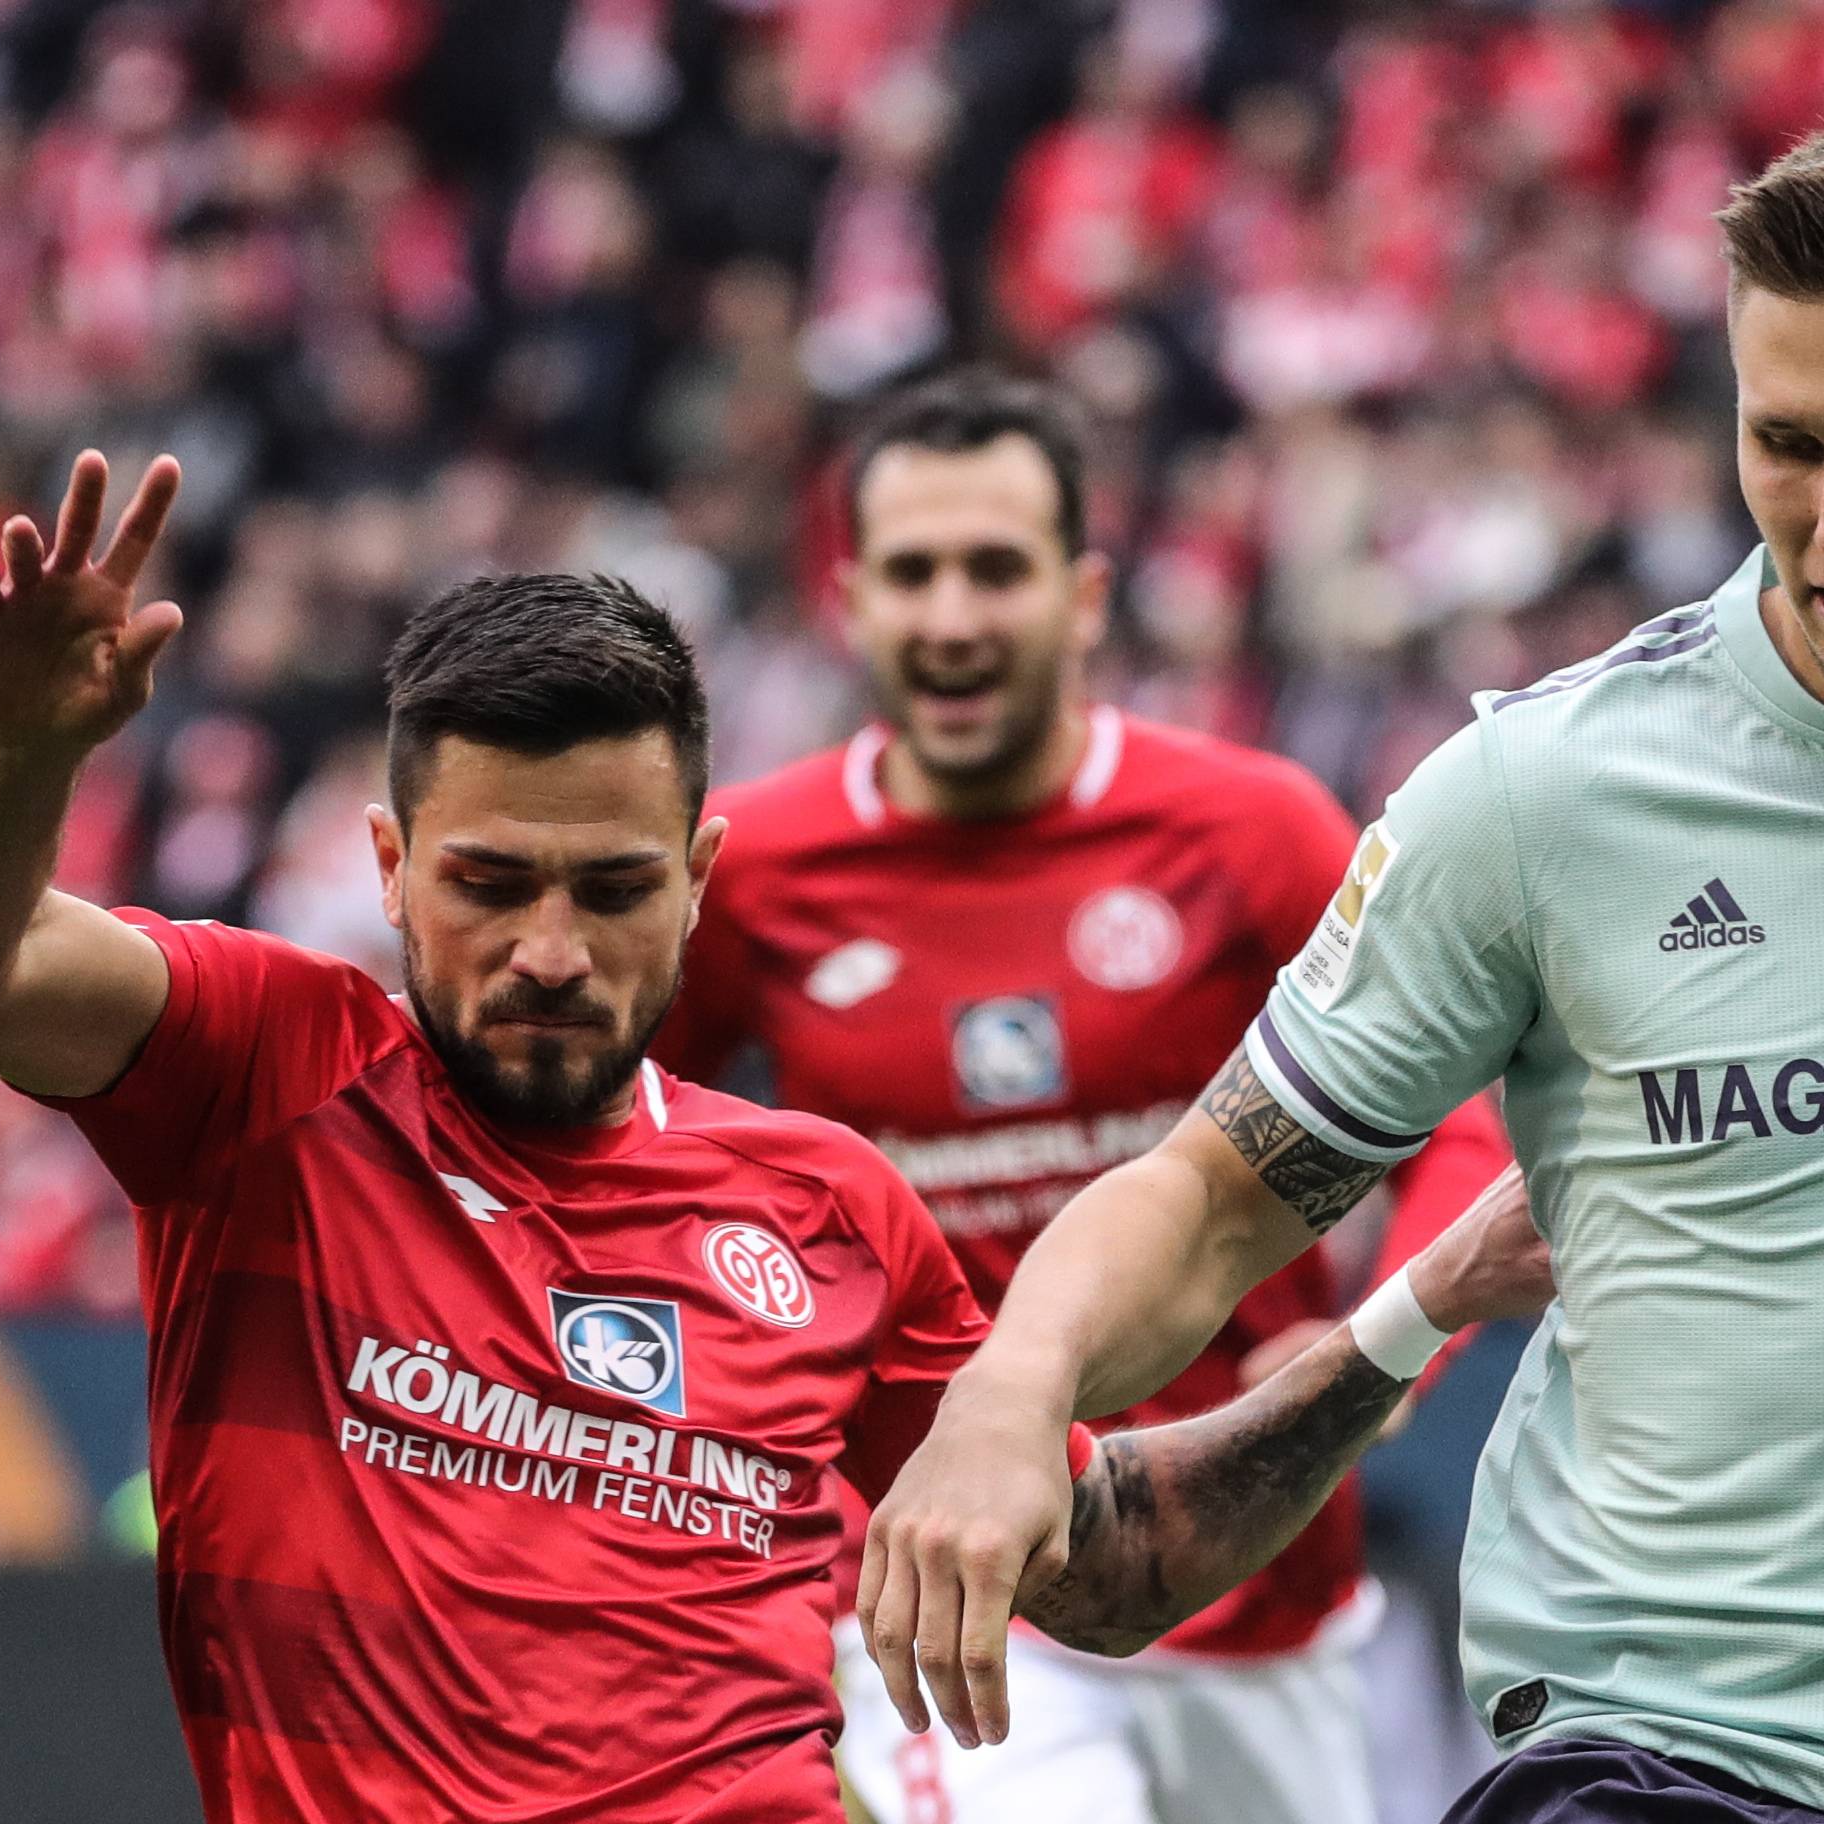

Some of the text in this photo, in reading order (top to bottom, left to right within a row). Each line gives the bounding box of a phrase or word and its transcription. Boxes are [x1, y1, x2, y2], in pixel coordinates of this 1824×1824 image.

[1659, 921, 1766, 952] adidas
[338, 1416, 775, 1560] PREMIUM FENSTER
